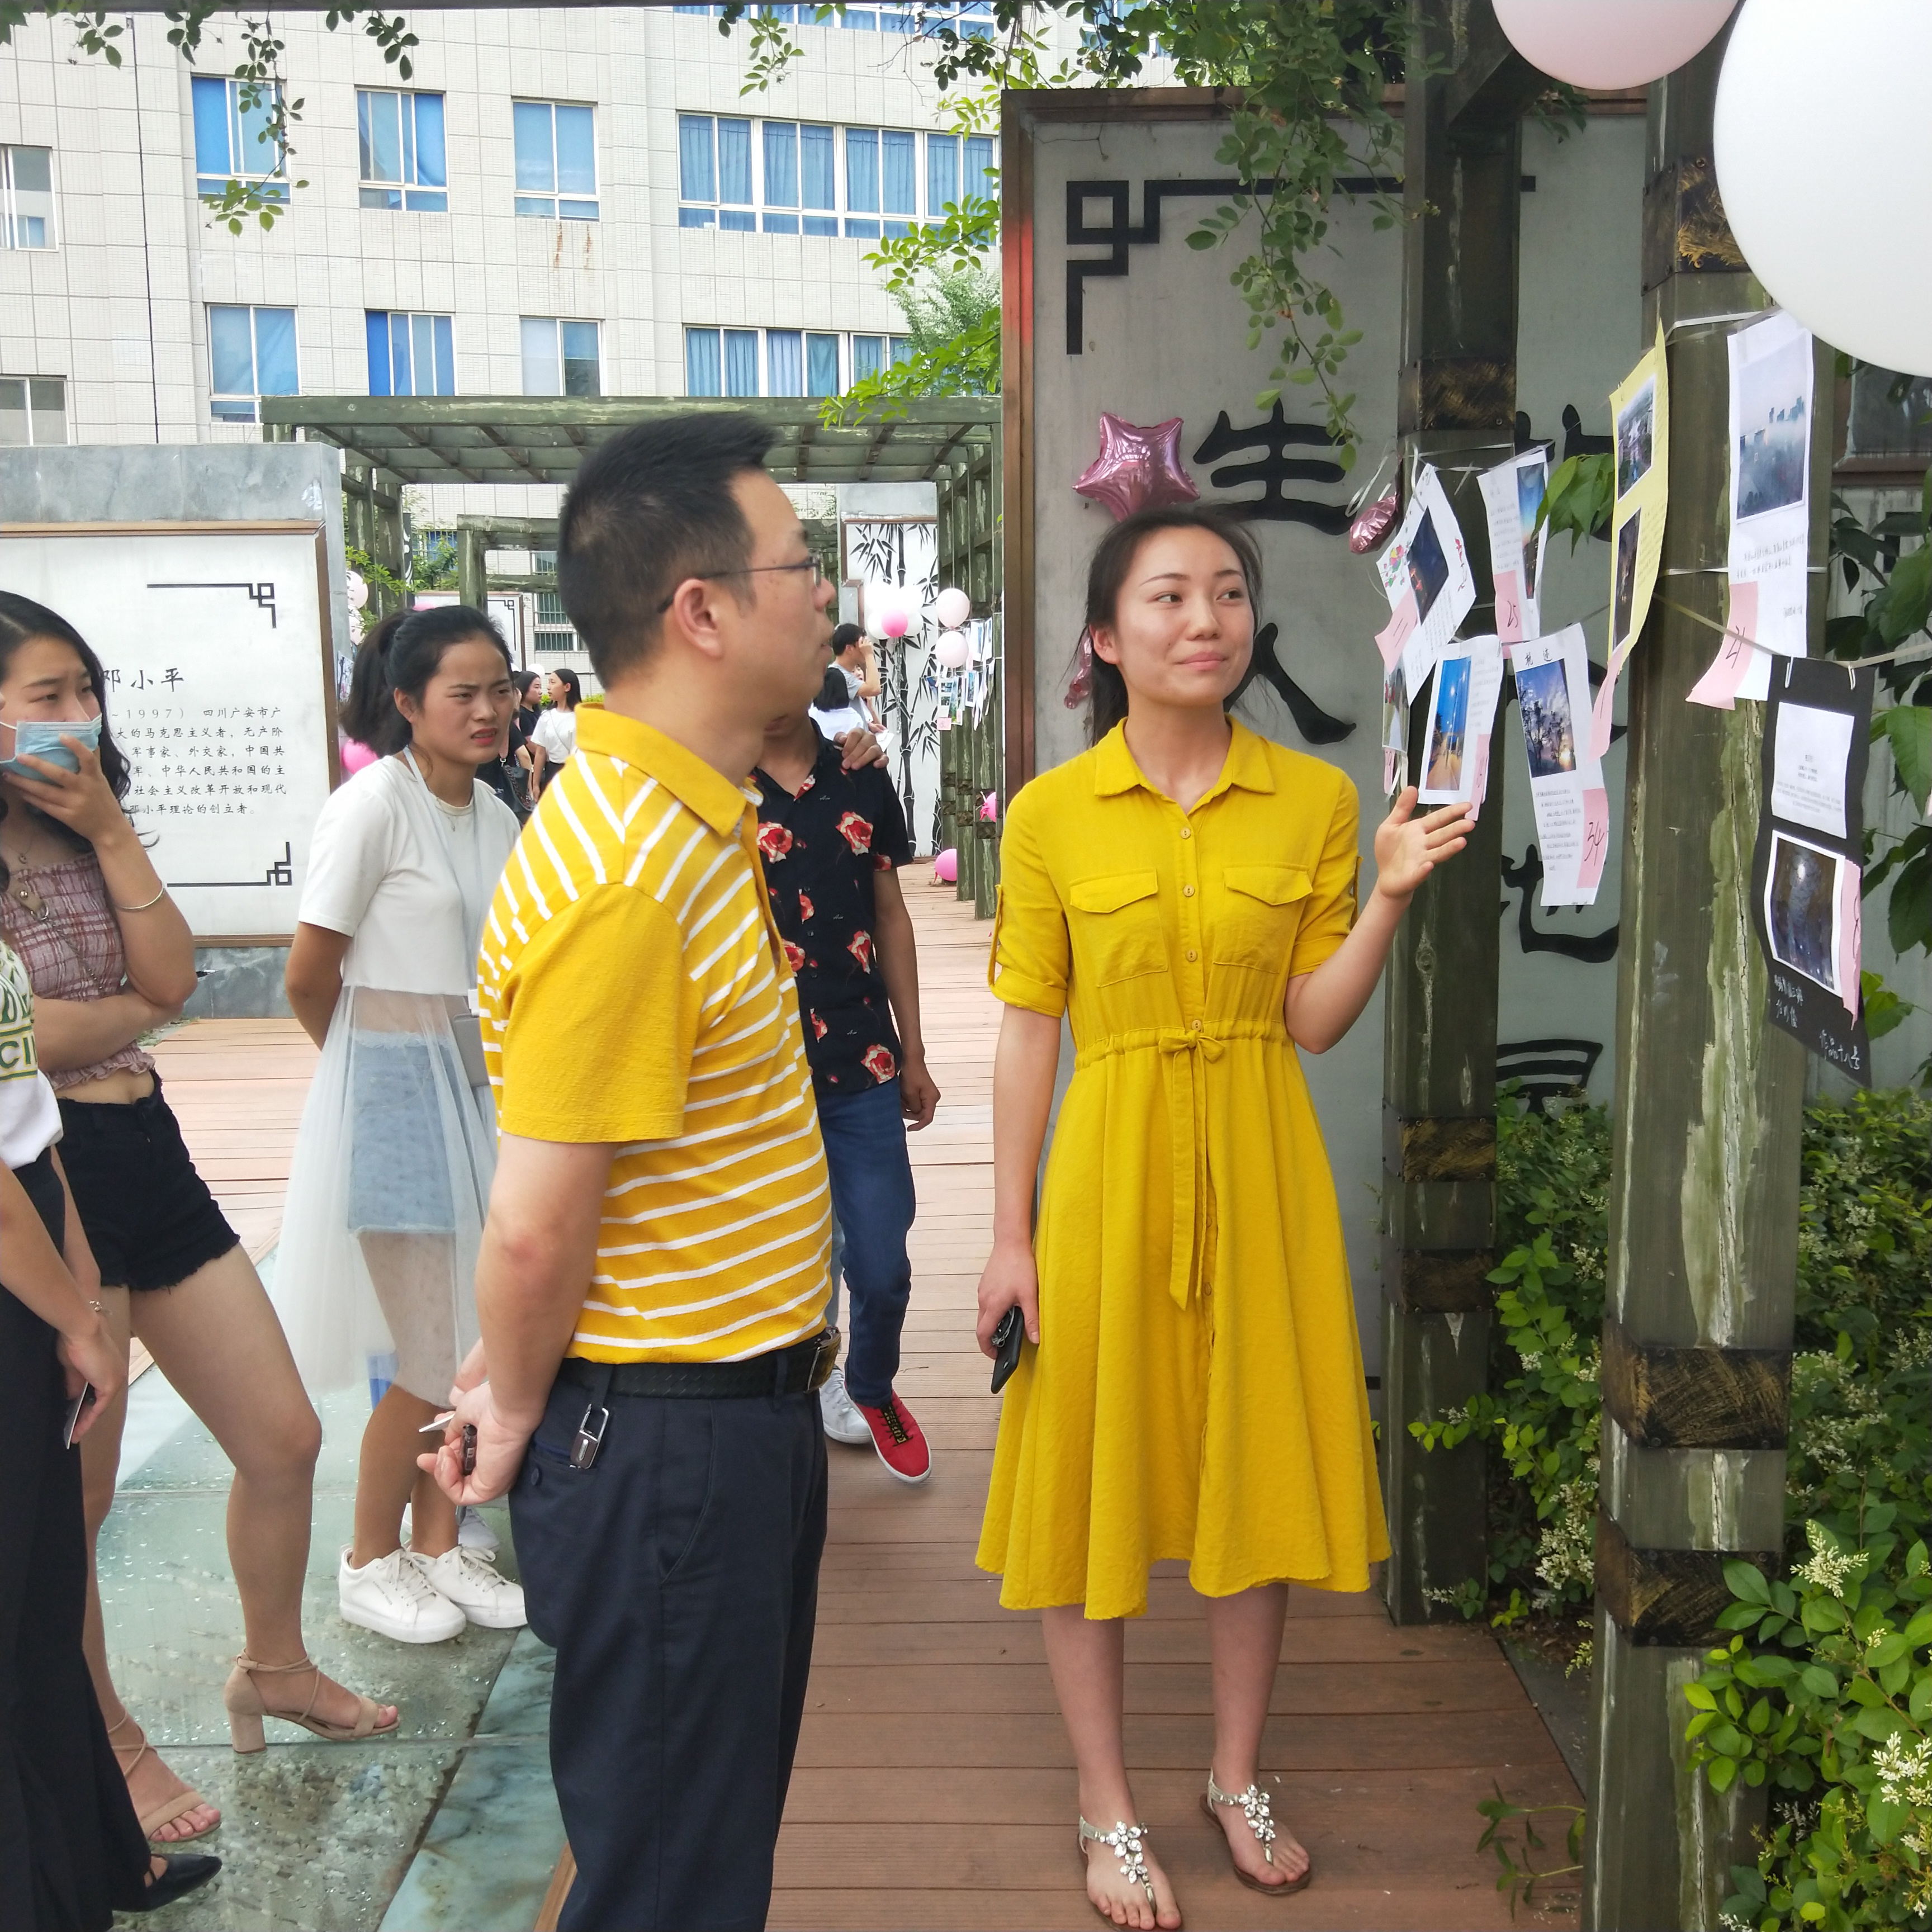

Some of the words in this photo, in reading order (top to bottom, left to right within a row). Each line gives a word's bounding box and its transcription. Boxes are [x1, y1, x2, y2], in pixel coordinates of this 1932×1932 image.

[102, 667, 184, 693] 邓小平
[127, 783, 287, 796] 社会主义改革开放和现代
[0, 1037, 37, 1069] CI
